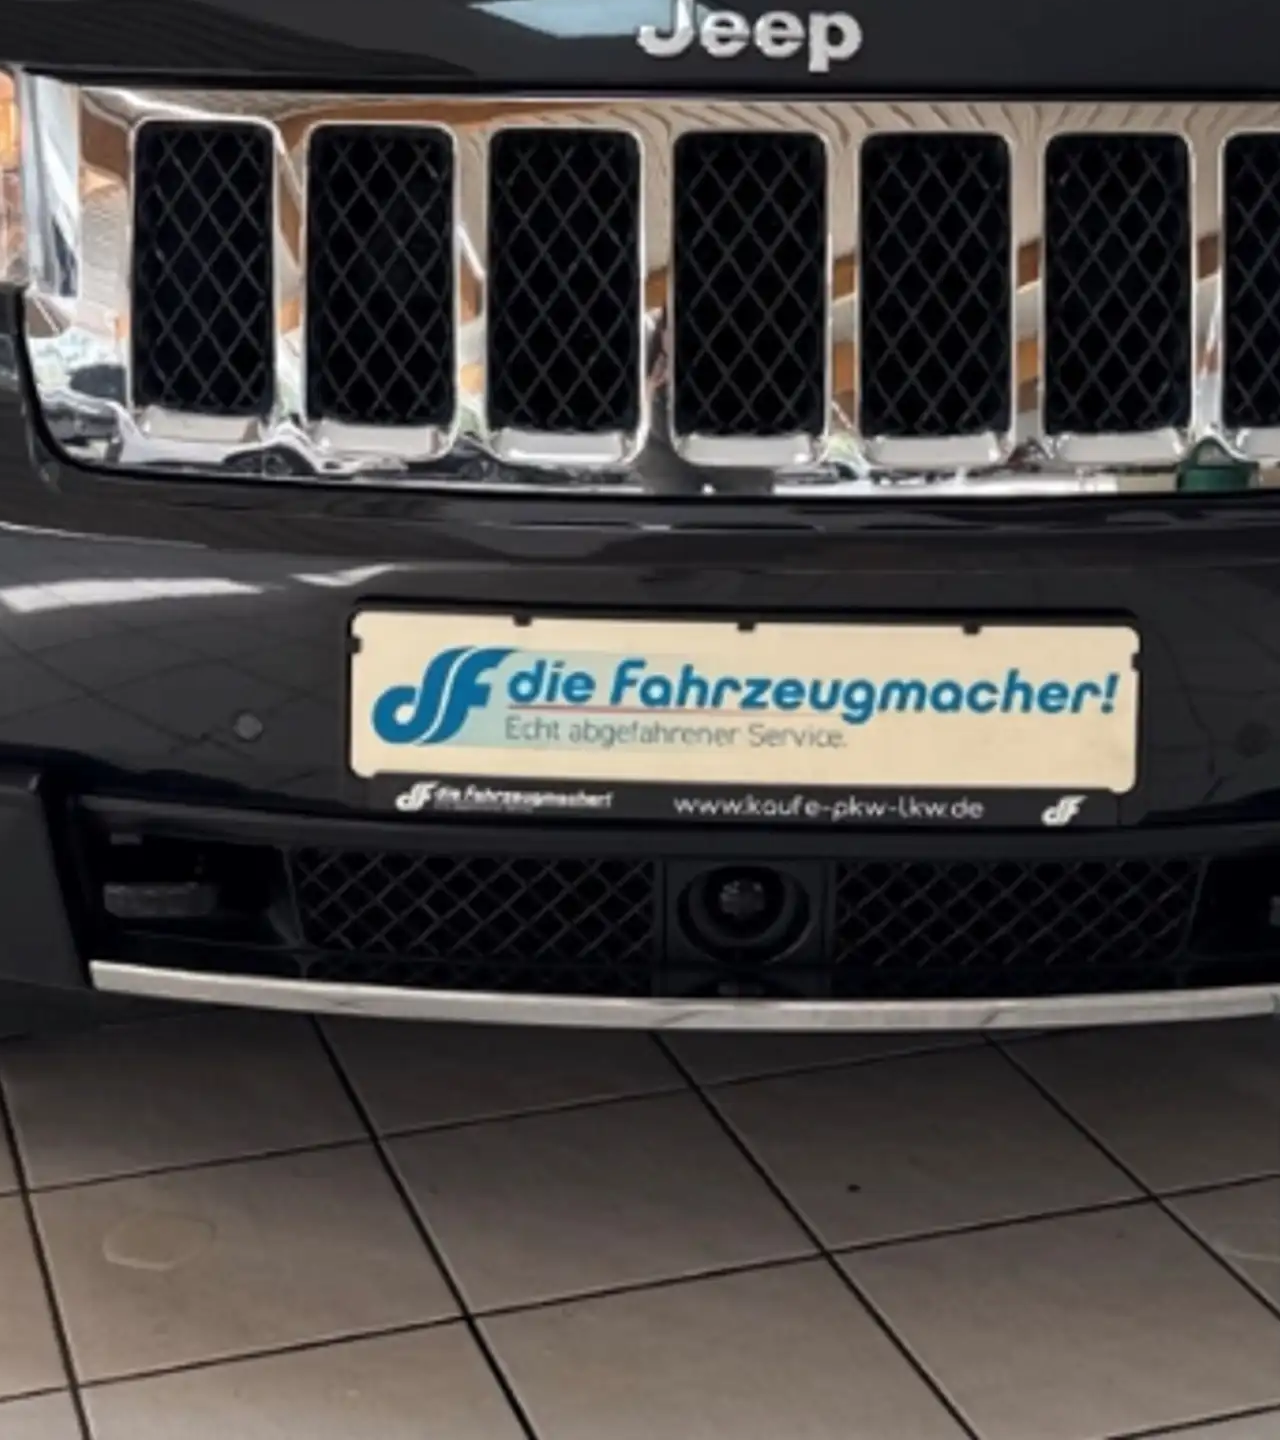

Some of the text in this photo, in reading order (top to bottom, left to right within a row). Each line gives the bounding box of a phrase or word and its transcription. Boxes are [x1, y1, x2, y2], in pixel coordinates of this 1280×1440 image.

[507, 657, 1120, 725] die Fahrzeugmacher!
[504, 716, 561, 742] Echt
[568, 719, 741, 751] abgefahrener
